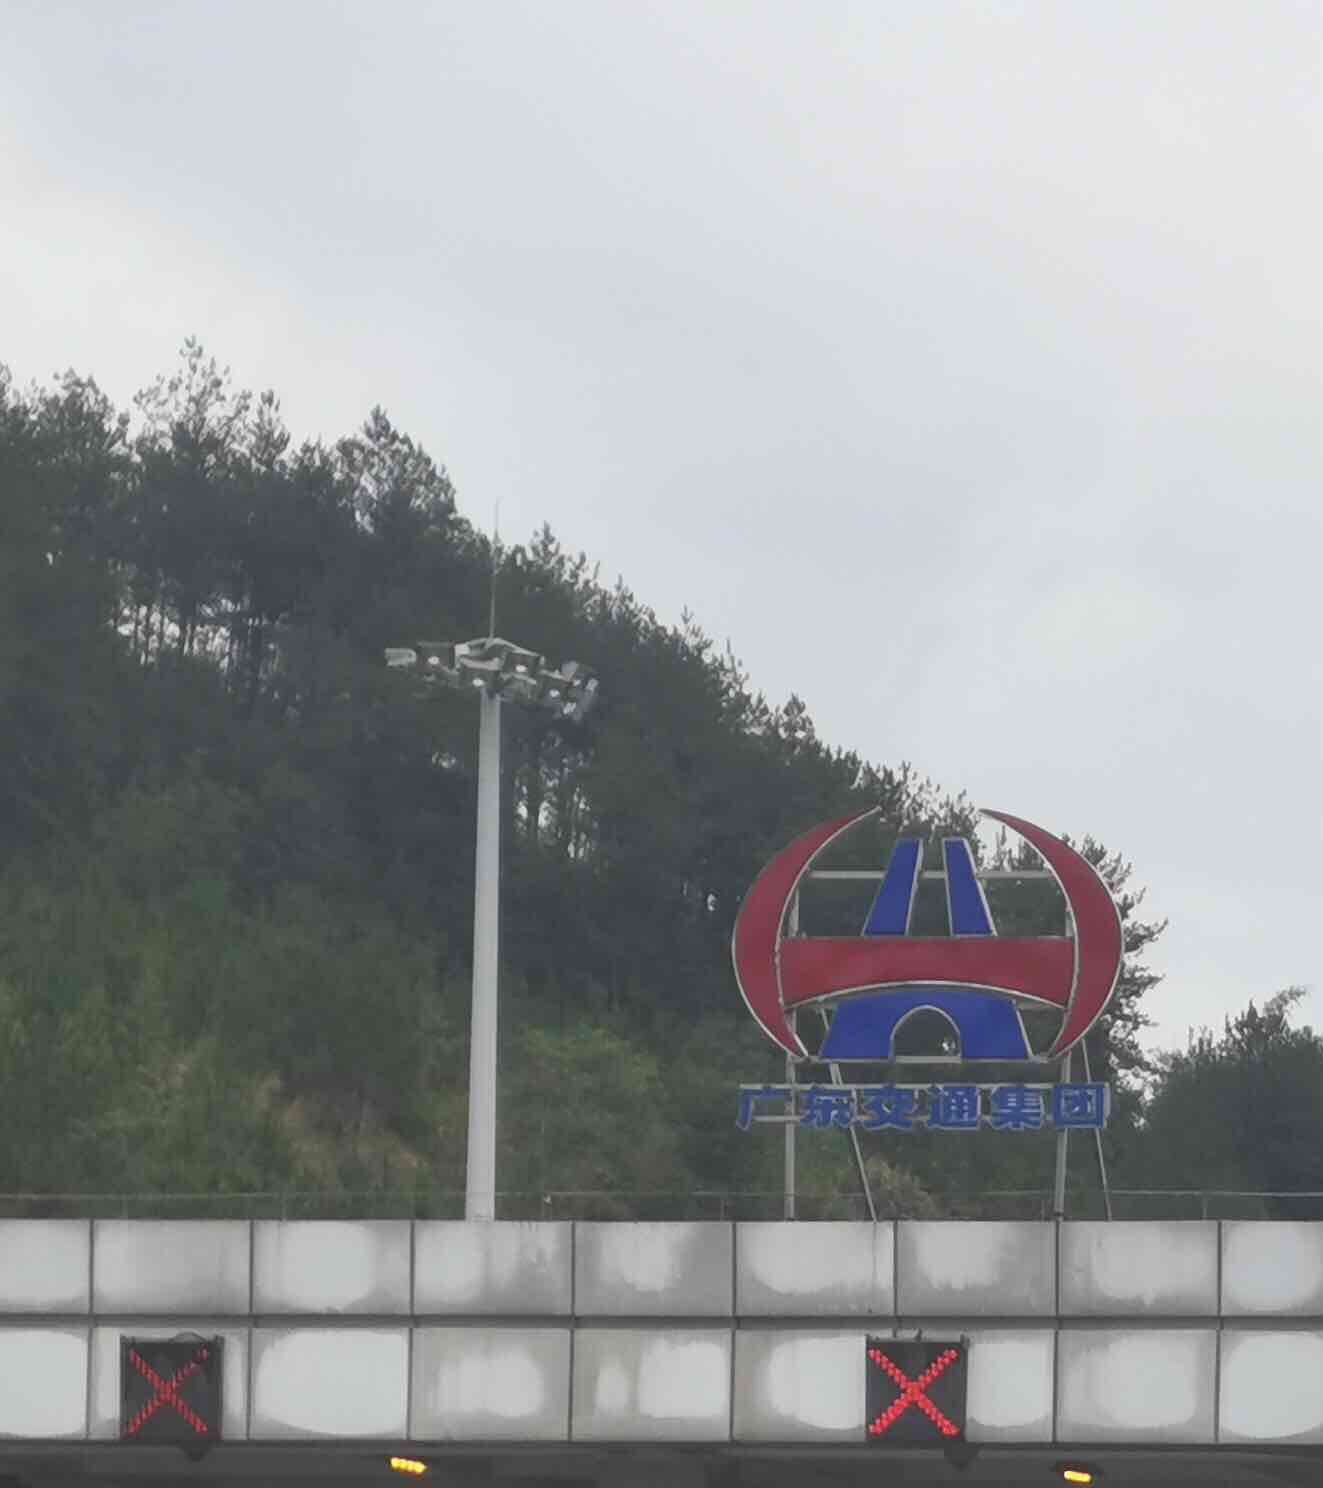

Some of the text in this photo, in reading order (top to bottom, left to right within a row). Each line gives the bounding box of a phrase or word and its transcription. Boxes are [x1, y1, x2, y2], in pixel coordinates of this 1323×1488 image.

[736, 1082, 1111, 1131] 广东交通集团
